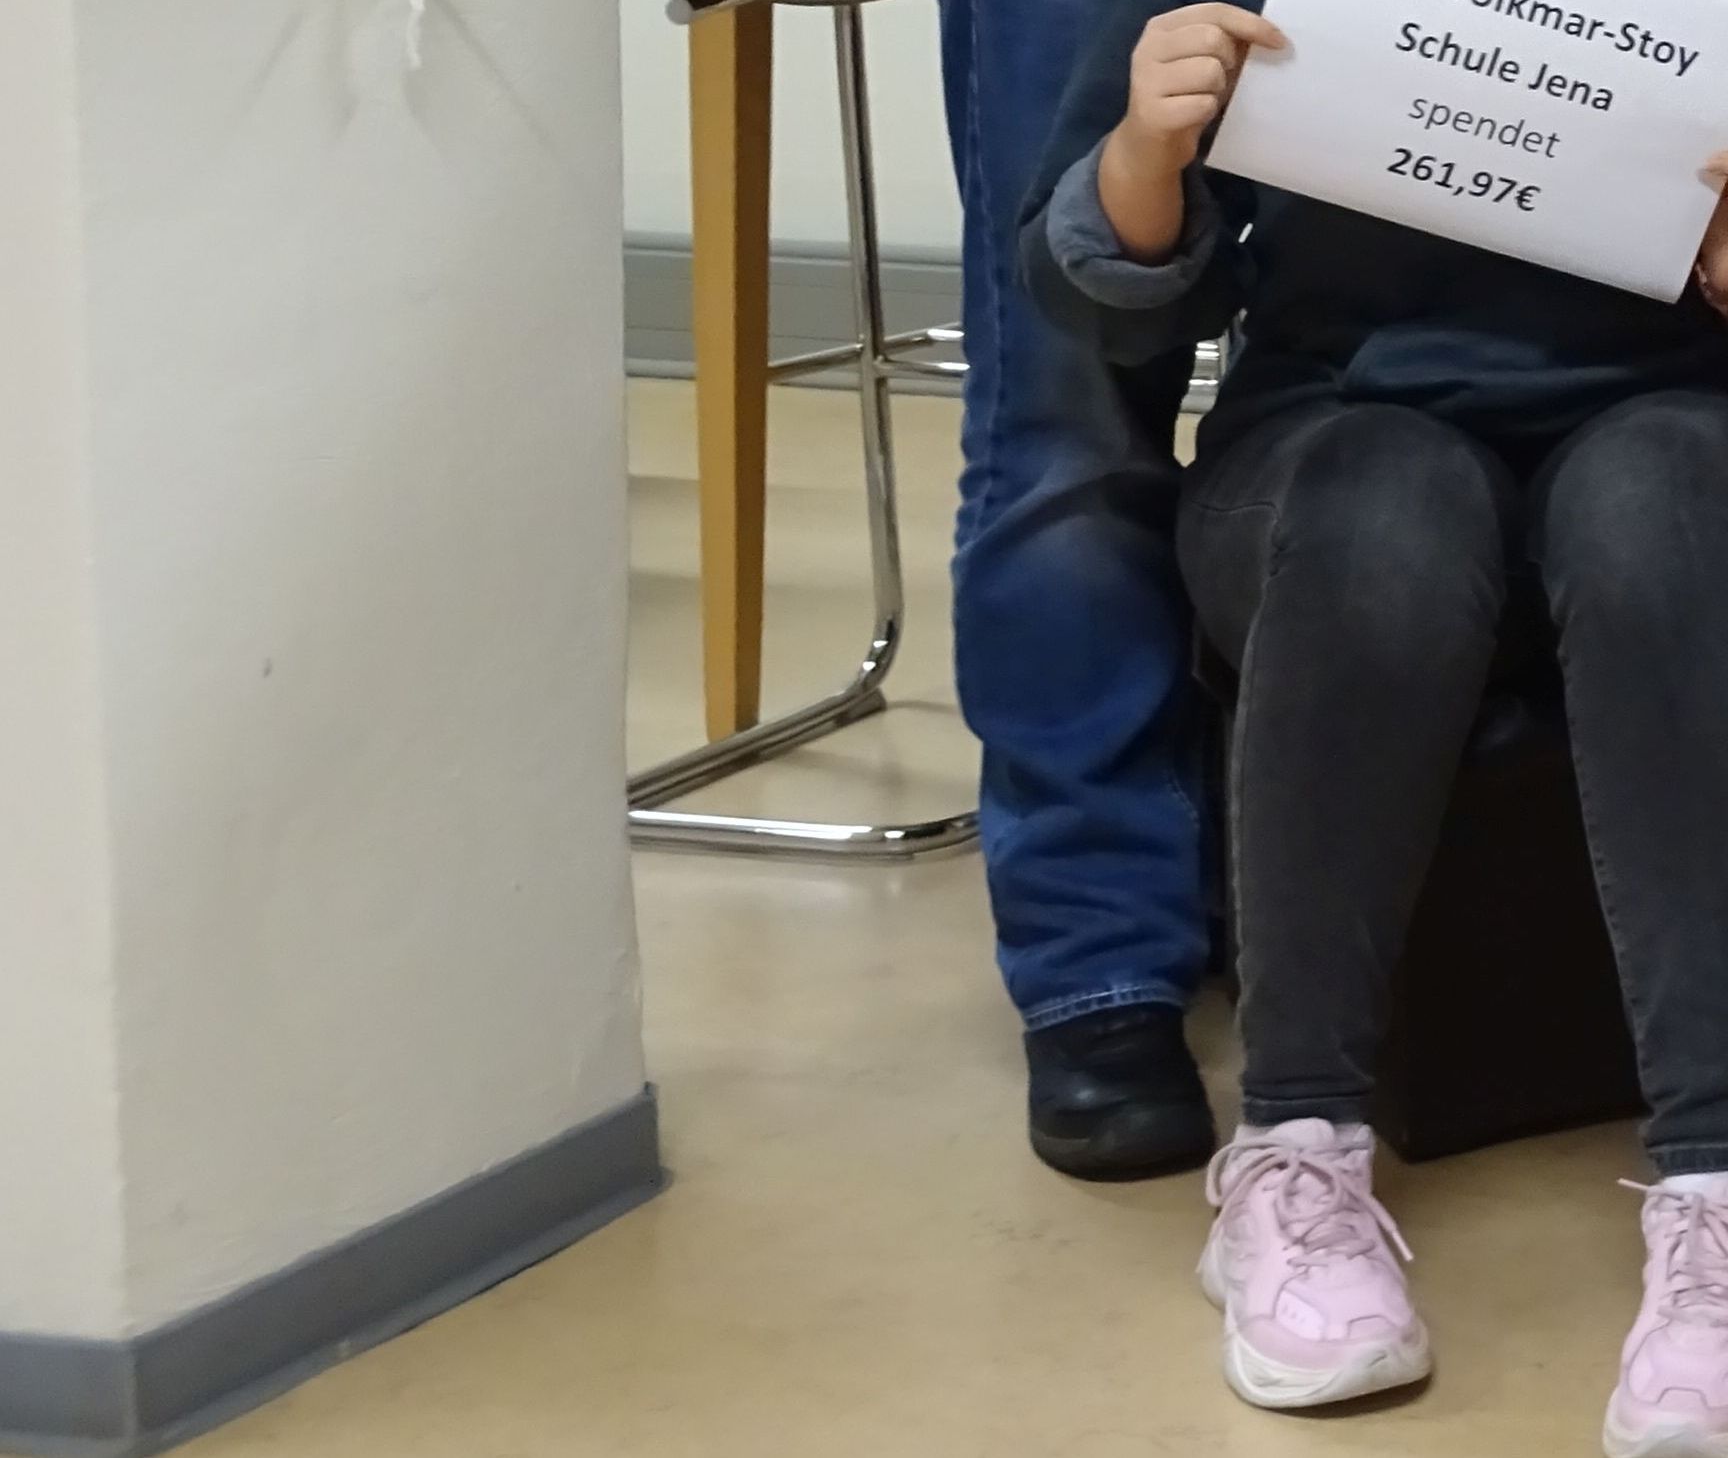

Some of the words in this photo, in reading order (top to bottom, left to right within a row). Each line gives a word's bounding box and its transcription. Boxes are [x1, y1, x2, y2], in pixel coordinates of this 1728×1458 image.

[1395, 22, 1521, 83] Schule
[1528, 63, 1614, 111] Jena
[1408, 98, 1561, 159] spendet
[1387, 148, 1542, 213] 261,97€
